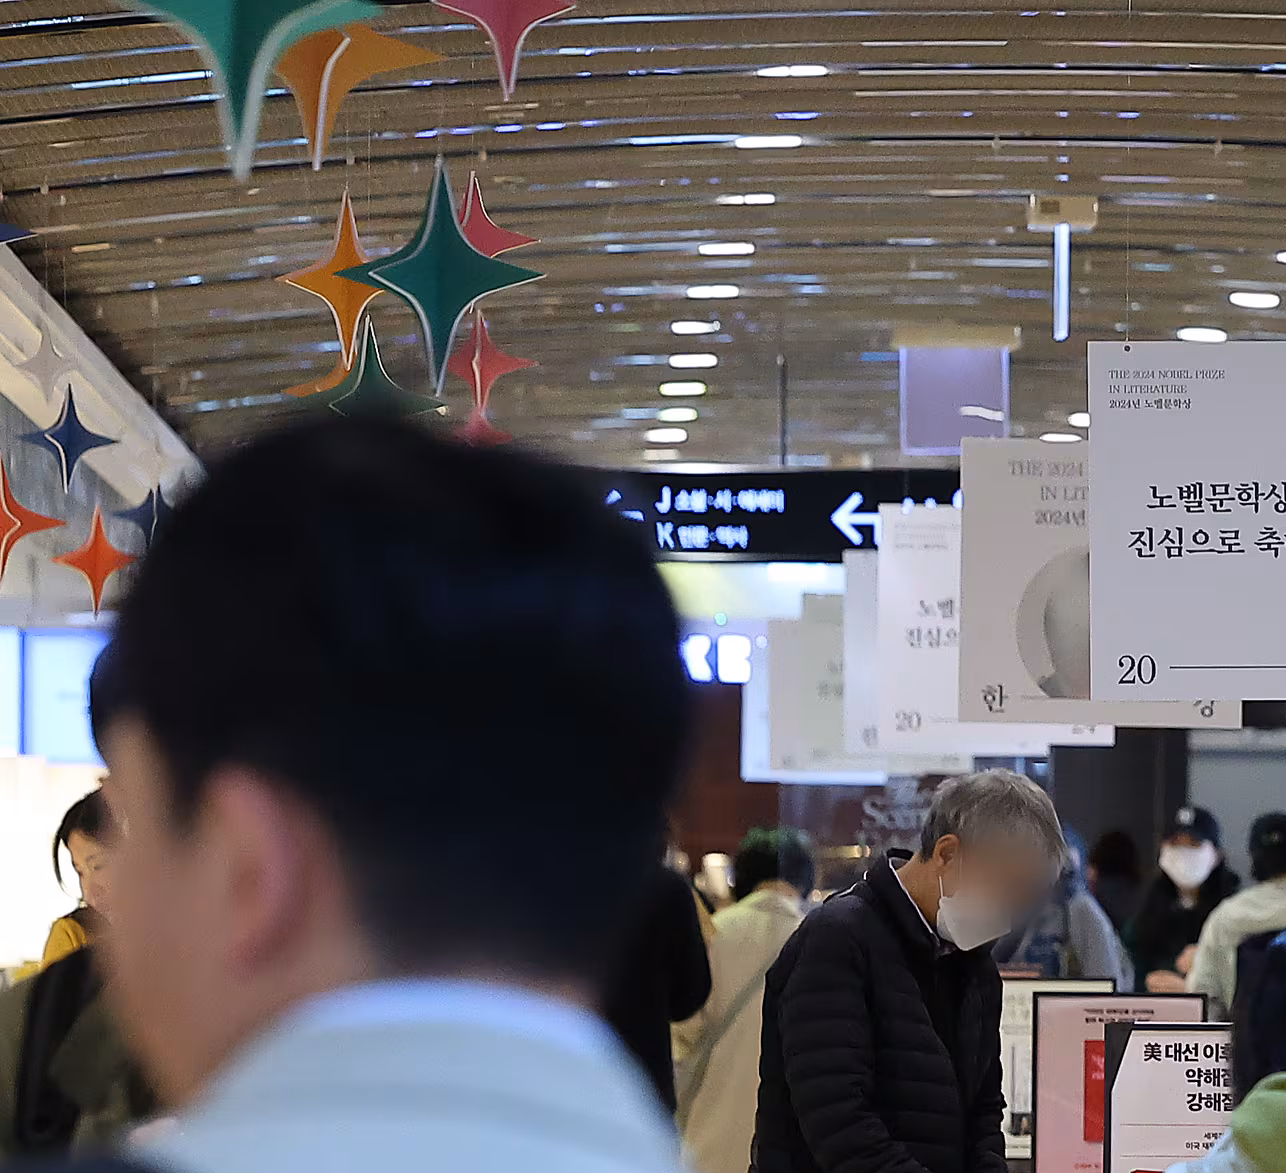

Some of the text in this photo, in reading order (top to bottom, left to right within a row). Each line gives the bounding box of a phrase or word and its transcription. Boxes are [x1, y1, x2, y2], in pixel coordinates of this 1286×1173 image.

[1108, 370, 1225, 379] THE 2024 NOBEL PRIZE
[1109, 385, 1188, 394] IN LITERATURE
[1109, 398, 1191, 409] 2024년 노벨문학상
[1009, 460, 1084, 477] THE 2024
[655, 485, 672, 514] J
[1040, 486, 1057, 501] IN
[655, 521, 675, 549] K
[1128, 527, 1245, 559] 진심으로
[1118, 655, 1157, 684] 20
[982, 684, 1008, 713] 한
[1143, 1043, 1161, 1061] 美
[1165, 1043, 1199, 1062] 대선
